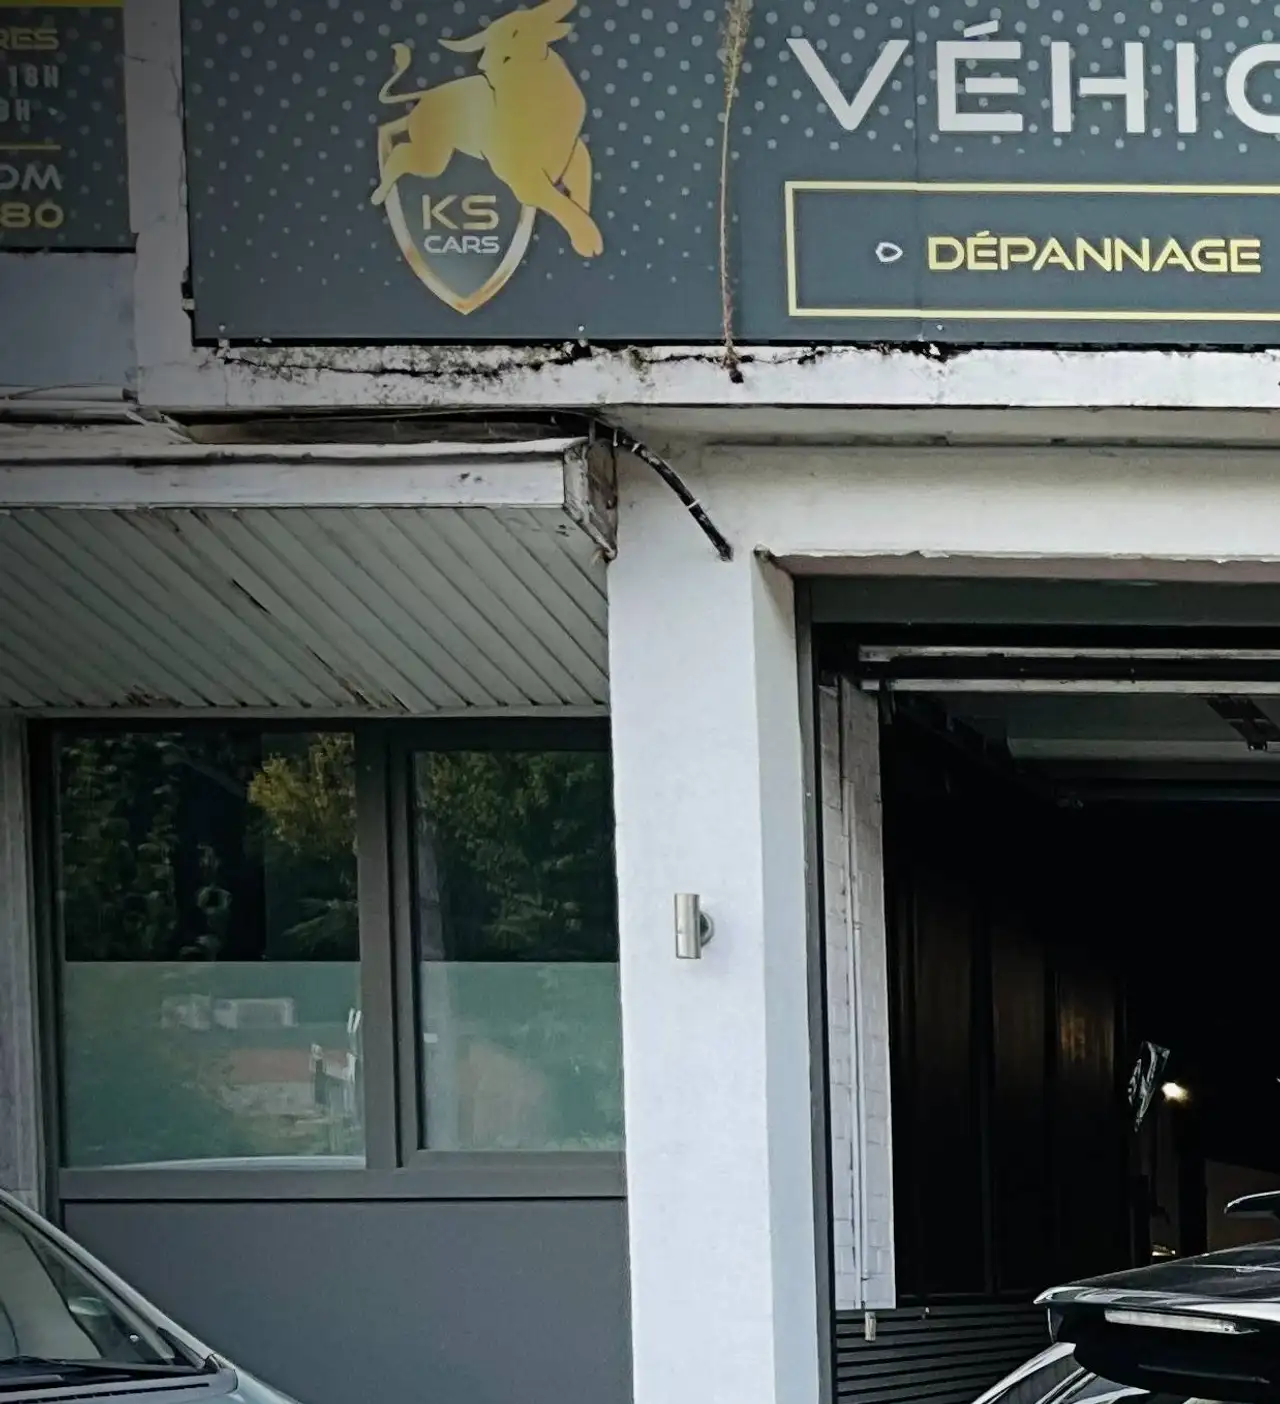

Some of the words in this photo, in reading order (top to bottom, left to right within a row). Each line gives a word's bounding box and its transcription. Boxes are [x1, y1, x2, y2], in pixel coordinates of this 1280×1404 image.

[421, 193, 500, 231] KS
[423, 234, 501, 254] CARS
[927, 230, 1262, 274] DÉPANNAGE
